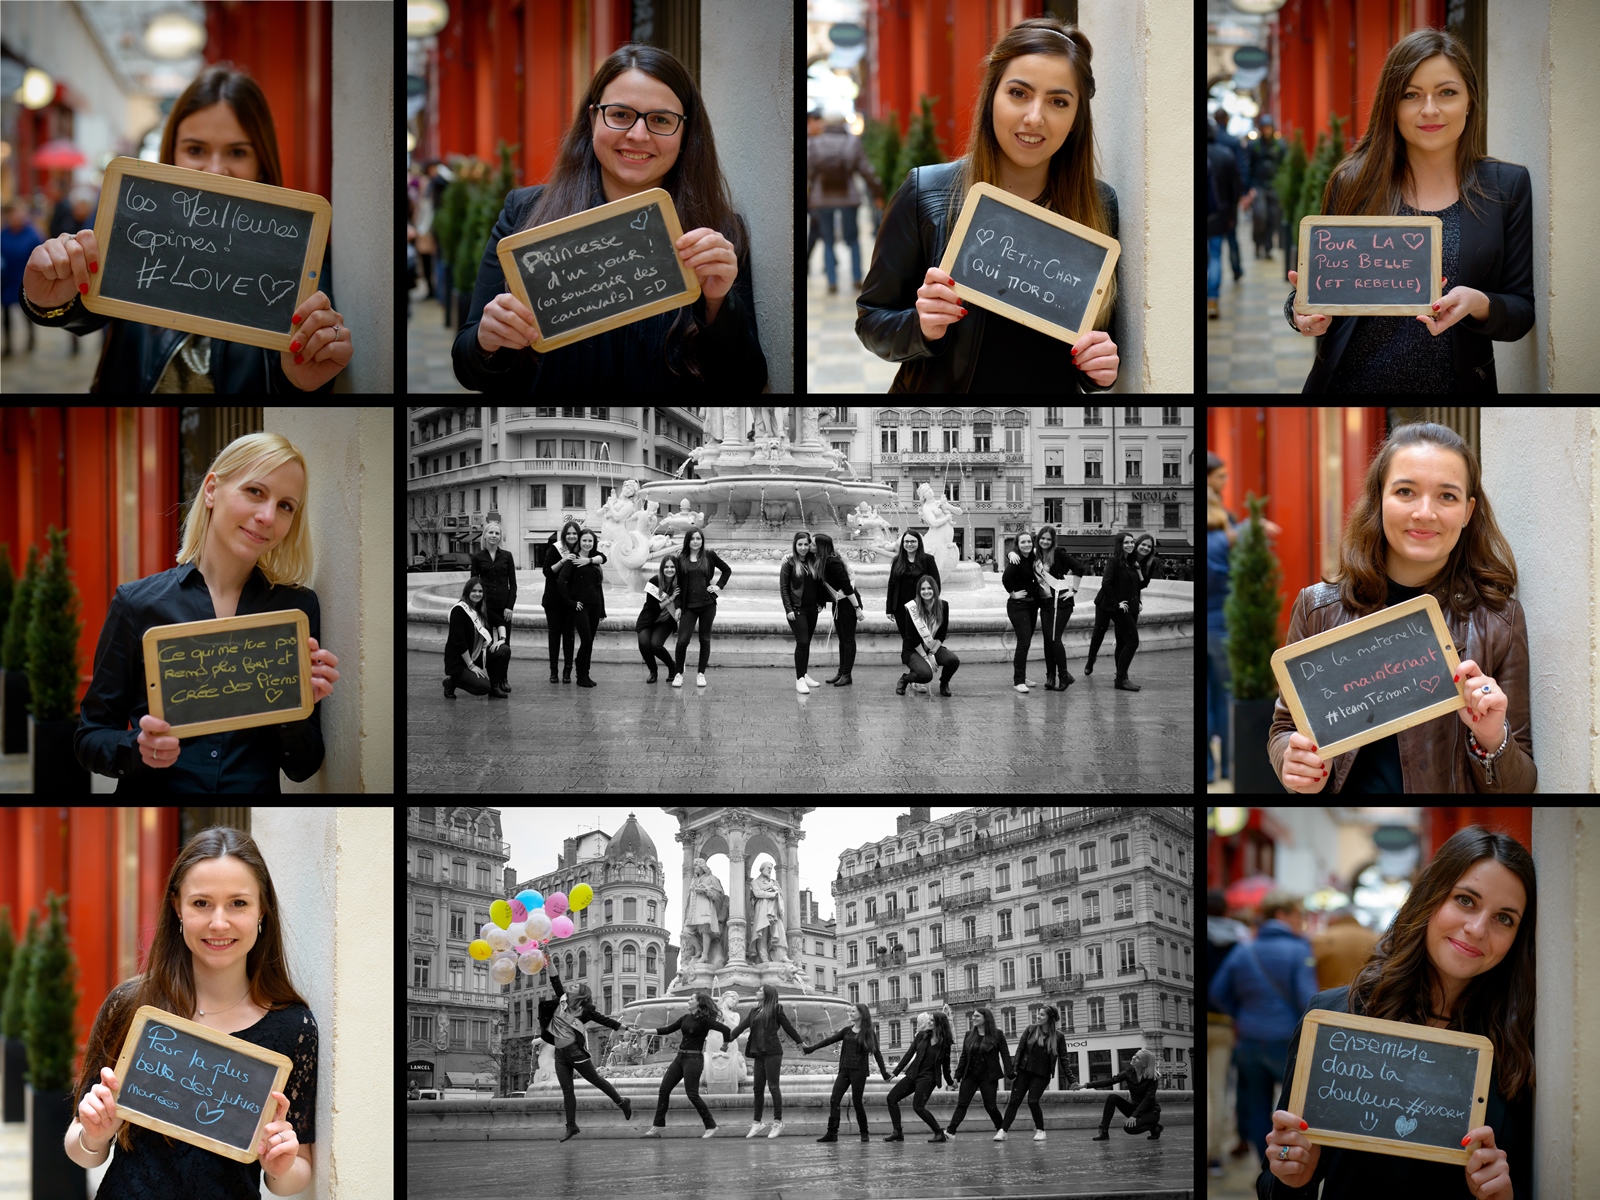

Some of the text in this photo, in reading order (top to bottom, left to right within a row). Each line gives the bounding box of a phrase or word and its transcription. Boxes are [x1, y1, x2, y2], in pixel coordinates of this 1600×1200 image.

[172, 191, 298, 238] Meilleures
[136, 256, 253, 295] #LOVE
[633, 266, 658, 281] des
[1315, 275, 1421, 293] (ET REBELLE)
[1131, 491, 1178, 501] NICOLAS
[158, 645, 187, 662] Ce
[218, 645, 238, 655] me
[275, 637, 297, 650] pas
[277, 650, 293, 665] et
[1300, 621, 1428, 681] De la maternelle
[1343, 647, 1437, 693] maintenant
[222, 680, 253, 694] des
[148, 1025, 249, 1085] Pour la plus
[1321, 1054, 1404, 1082] dans la
[135, 1052, 176, 1082] belle
[180, 1074, 214, 1097] des
